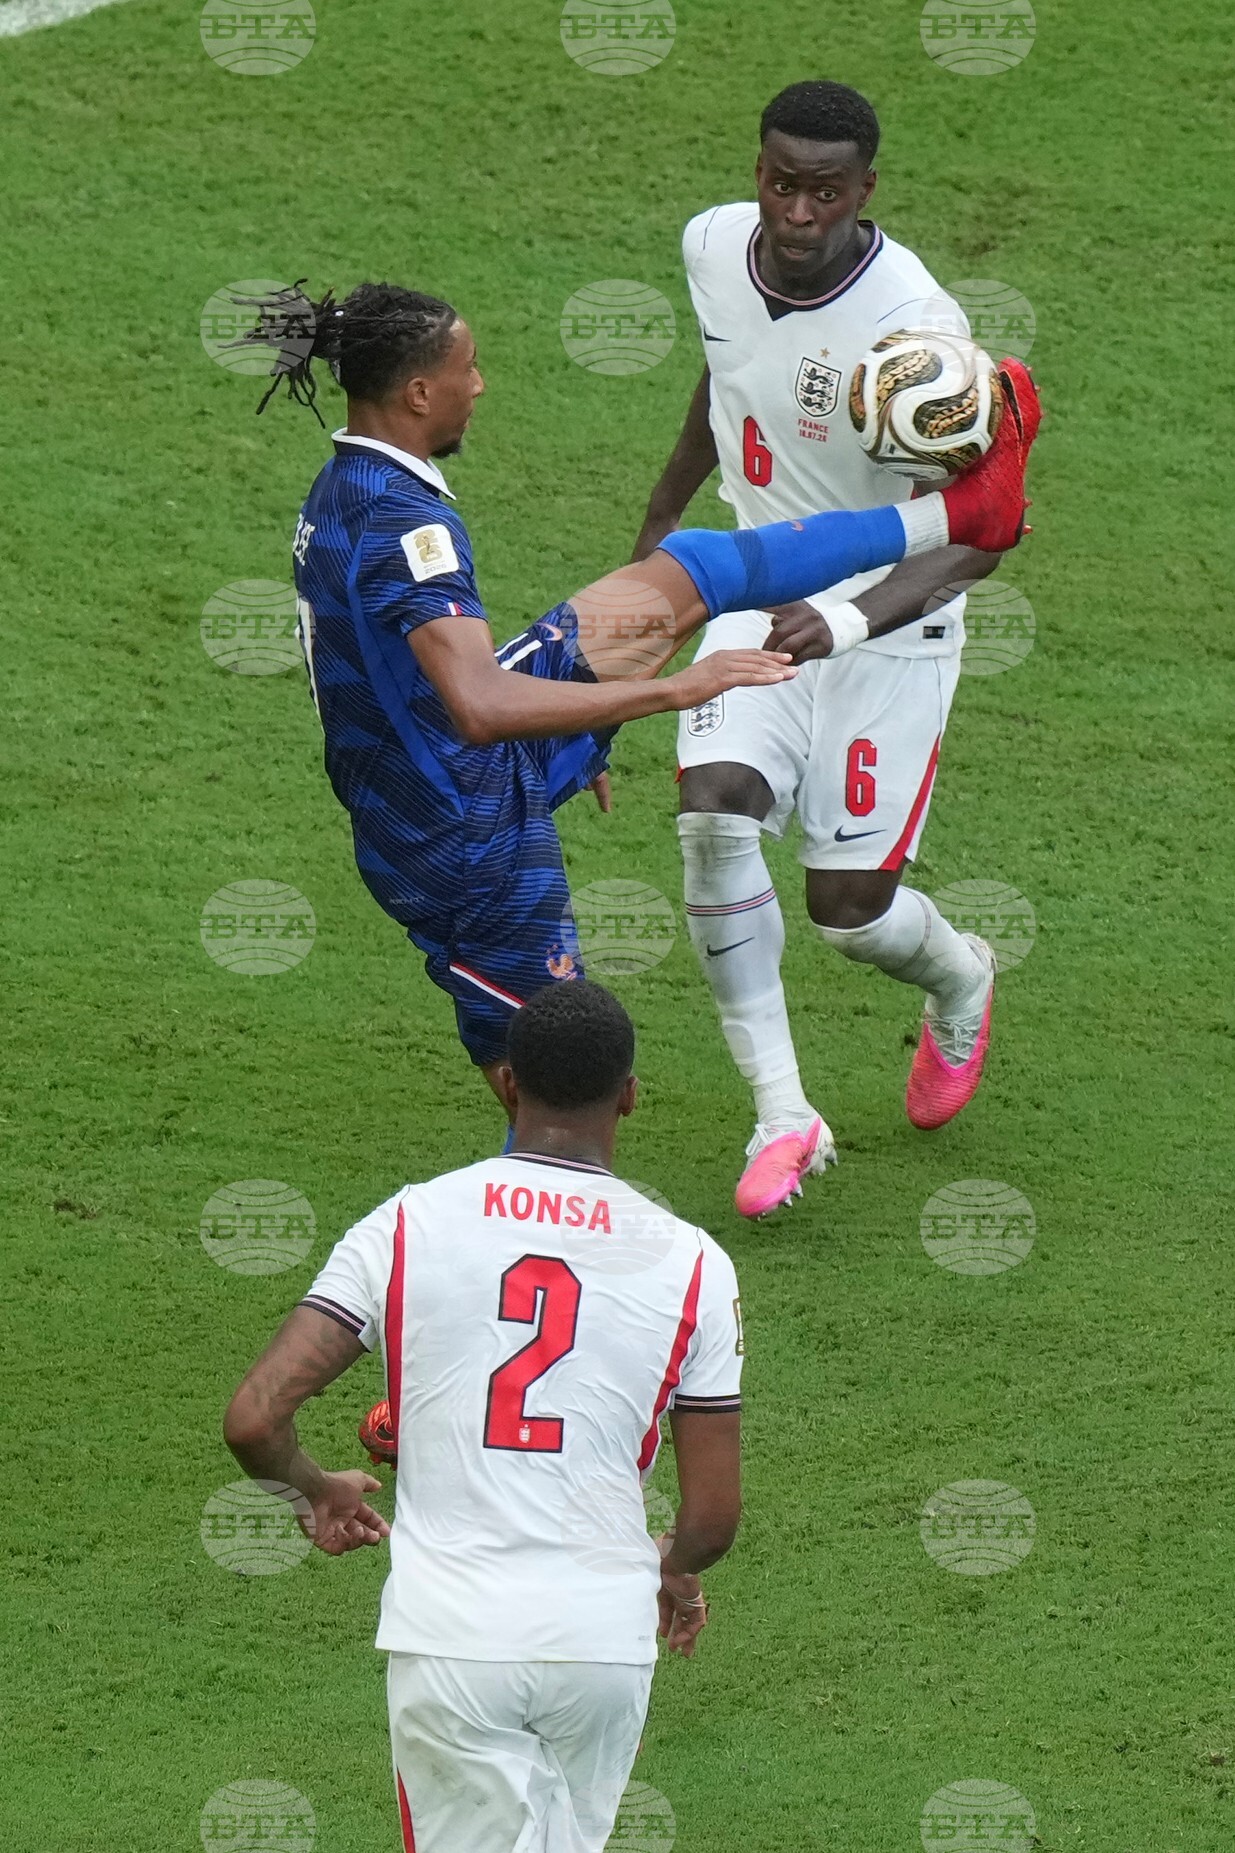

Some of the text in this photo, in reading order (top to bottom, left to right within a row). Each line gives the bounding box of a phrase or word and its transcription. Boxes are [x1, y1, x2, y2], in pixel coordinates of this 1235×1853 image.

[743, 415, 772, 487] 6
[798, 418, 829, 434] FRANCE
[845, 738, 877, 816] 6
[484, 1183, 612, 1234] KONSA
[483, 1254, 582, 1454] 2
